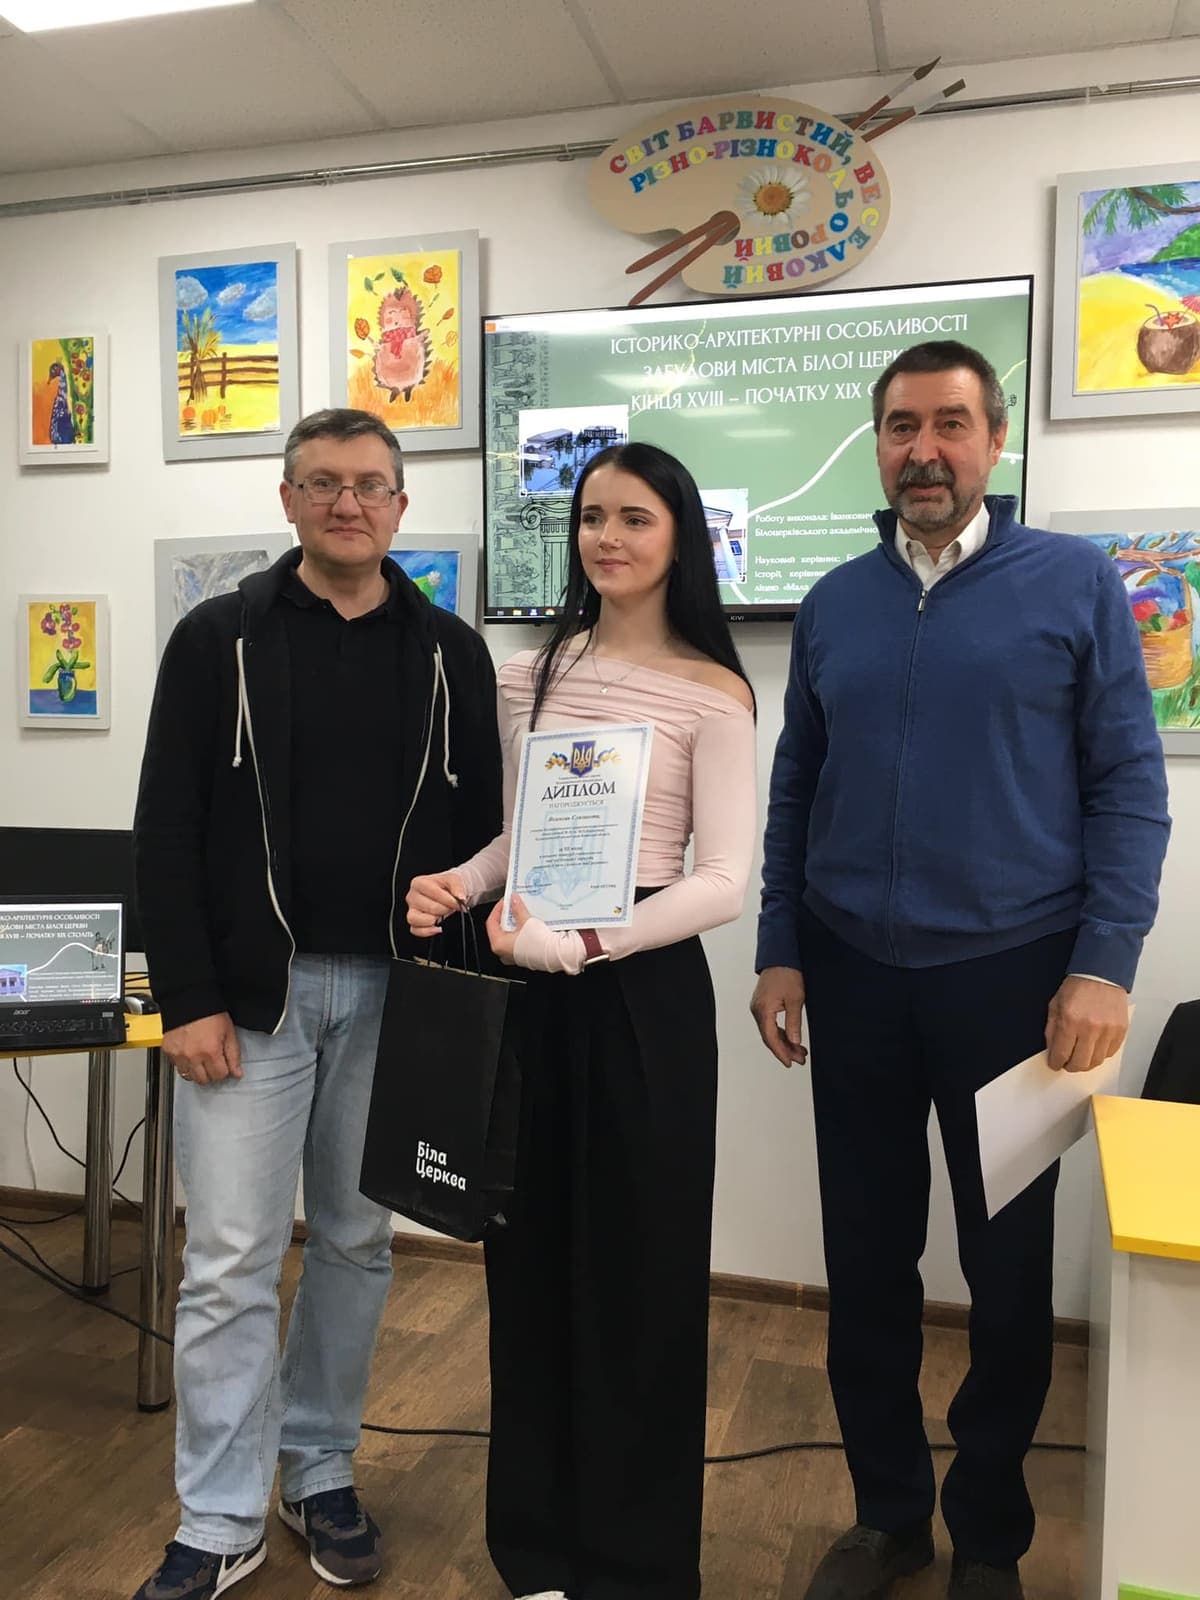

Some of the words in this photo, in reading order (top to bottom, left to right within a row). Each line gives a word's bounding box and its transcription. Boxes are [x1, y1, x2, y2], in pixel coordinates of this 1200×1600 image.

[609, 129, 669, 174] СВІТ
[676, 110, 853, 166] БАРВИСТИЙ,
[611, 325, 821, 354] ІСТОРИКО-АРХІТЕКТУРНІ
[826, 313, 968, 340] ОСОБЛИВОСТІ
[643, 359, 736, 382] ЗАБУДОВИ
[742, 356, 798, 376] МІСТА
[803, 352, 853, 371] БІЛОЇ
[859, 348, 904, 368] ЦЕРК
[631, 392, 682, 412] КІНЦЯ
[687, 390, 723, 408] XVIII
[745, 383, 830, 405] ПОЧАТКУ
[834, 381, 862, 399] XIX
[755, 513, 785, 524] Роботу
[829, 525, 880, 535] академічно
[541, 781, 616, 802] ДИПЛОМ
[417, 1140, 447, 1166] Біла
[416, 1158, 467, 1191] Церква
